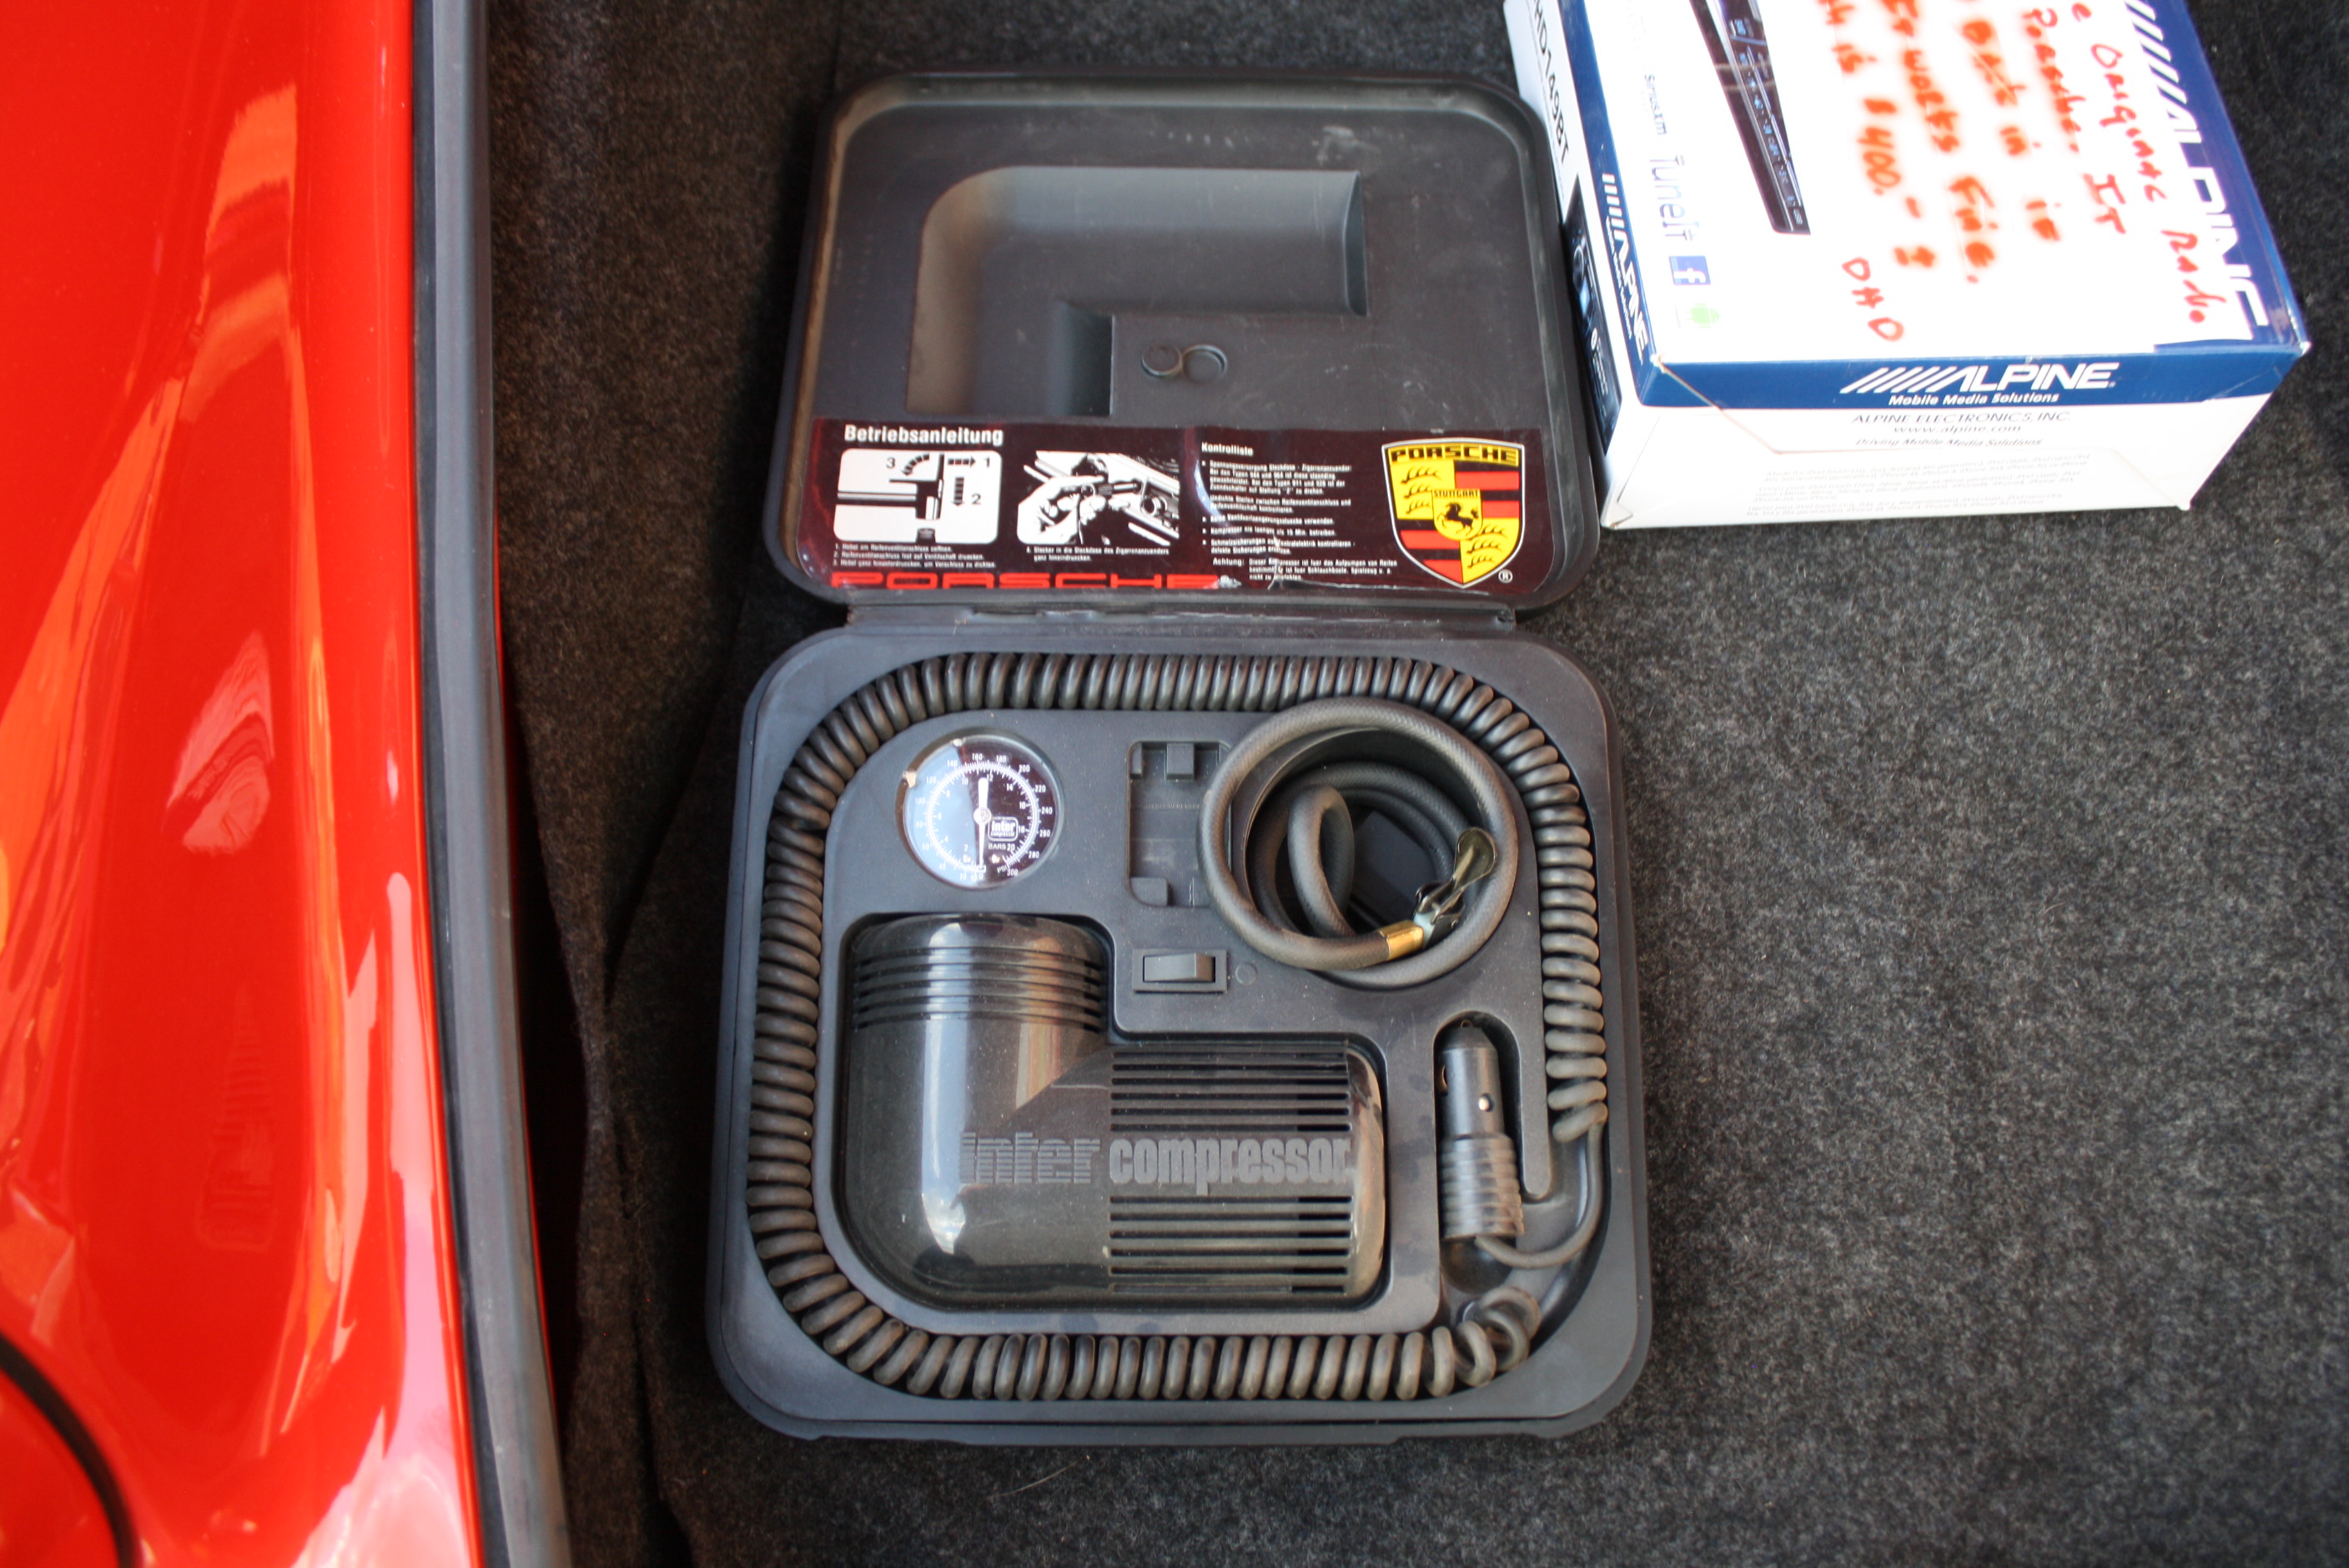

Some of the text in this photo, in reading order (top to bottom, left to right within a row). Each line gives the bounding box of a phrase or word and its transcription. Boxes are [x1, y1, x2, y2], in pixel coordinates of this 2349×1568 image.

[1924, 362, 2120, 393] ALPINE
[1889, 392, 2060, 406] Mobile Media Solutions
[1851, 413, 1909, 424] ALPINE
[844, 424, 1003, 447] Betriebsanleitung
[1201, 441, 1254, 456] Kontrolliste
[1390, 445, 1518, 465] PORSCHE
[885, 457, 897, 470] 3
[985, 457, 991, 469] 1
[972, 493, 981, 505] 2
[1433, 490, 1479, 498] STUTTGART
[1213, 557, 1244, 567] Achtung:
[832, 572, 1220, 590] PORSCHE
[959, 1132, 1351, 1197] inter compressor
